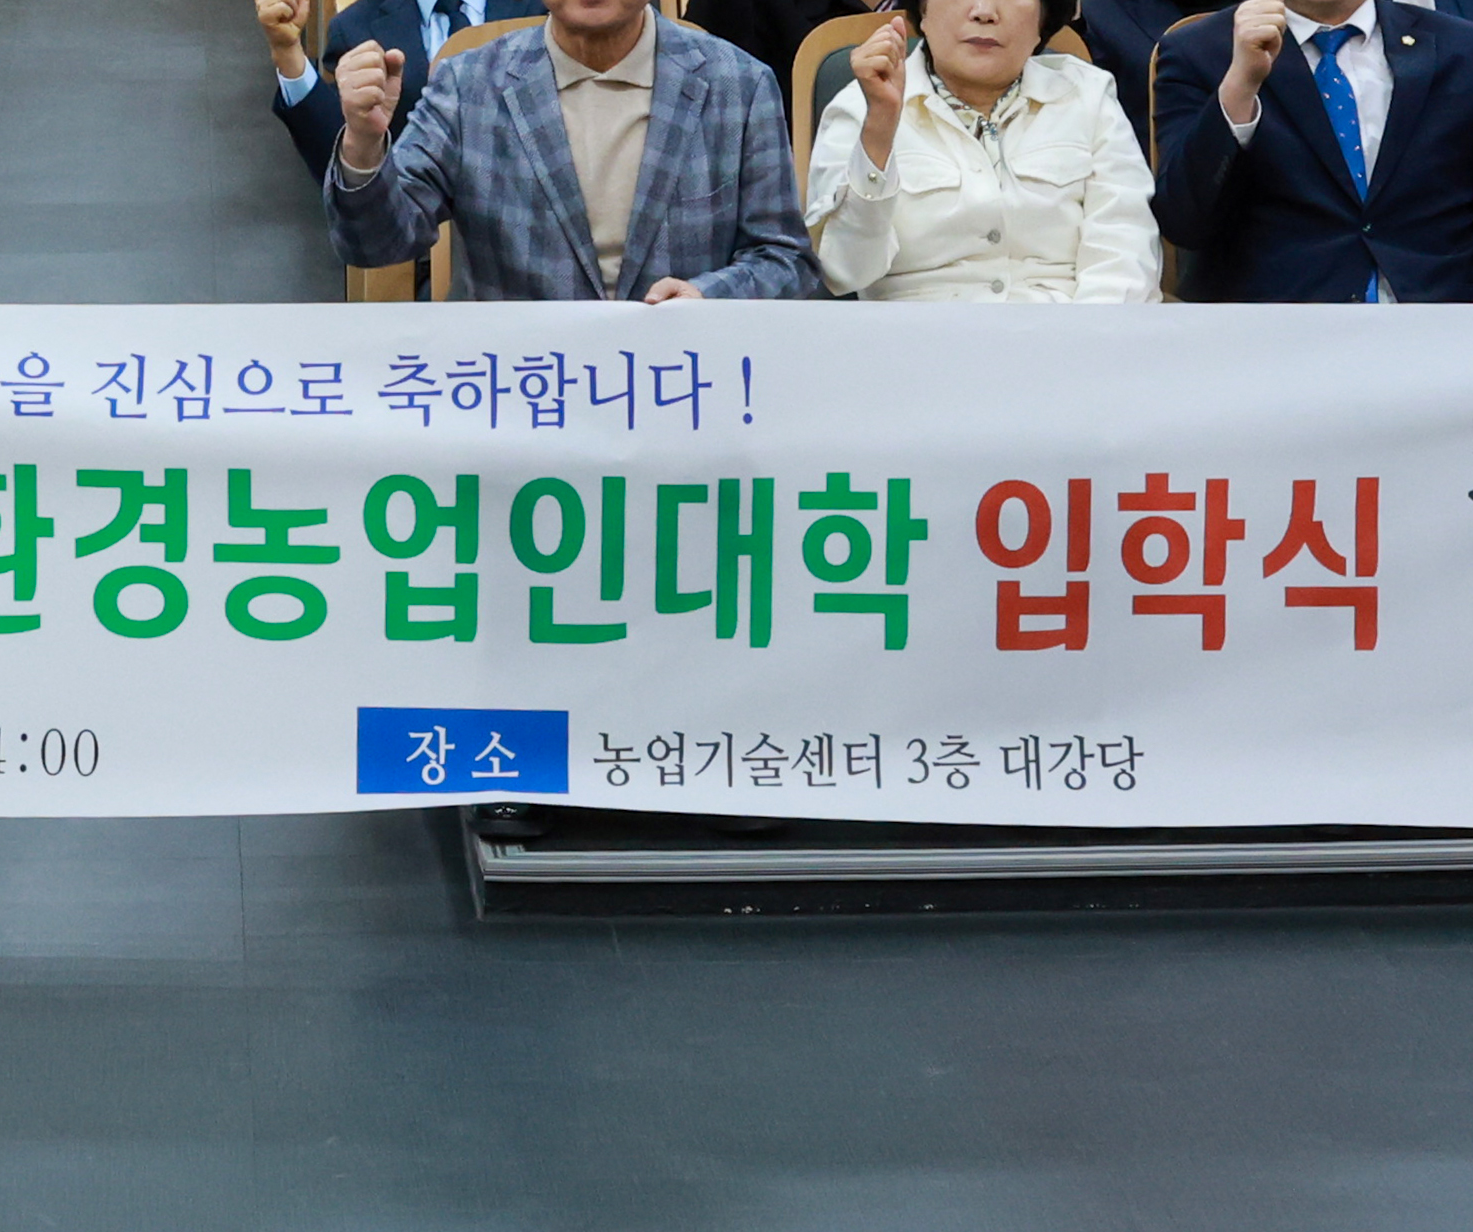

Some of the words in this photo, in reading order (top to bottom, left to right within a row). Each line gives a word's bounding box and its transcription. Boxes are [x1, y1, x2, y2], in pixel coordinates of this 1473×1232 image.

[92, 353, 353, 423] 진심으로
[377, 350, 713, 431] 축하합니다
[976, 473, 1379, 651] 입학식
[593, 731, 881, 789] 농업기술센터
[906, 734, 981, 790] 3층
[999, 734, 1144, 791] 대강당
